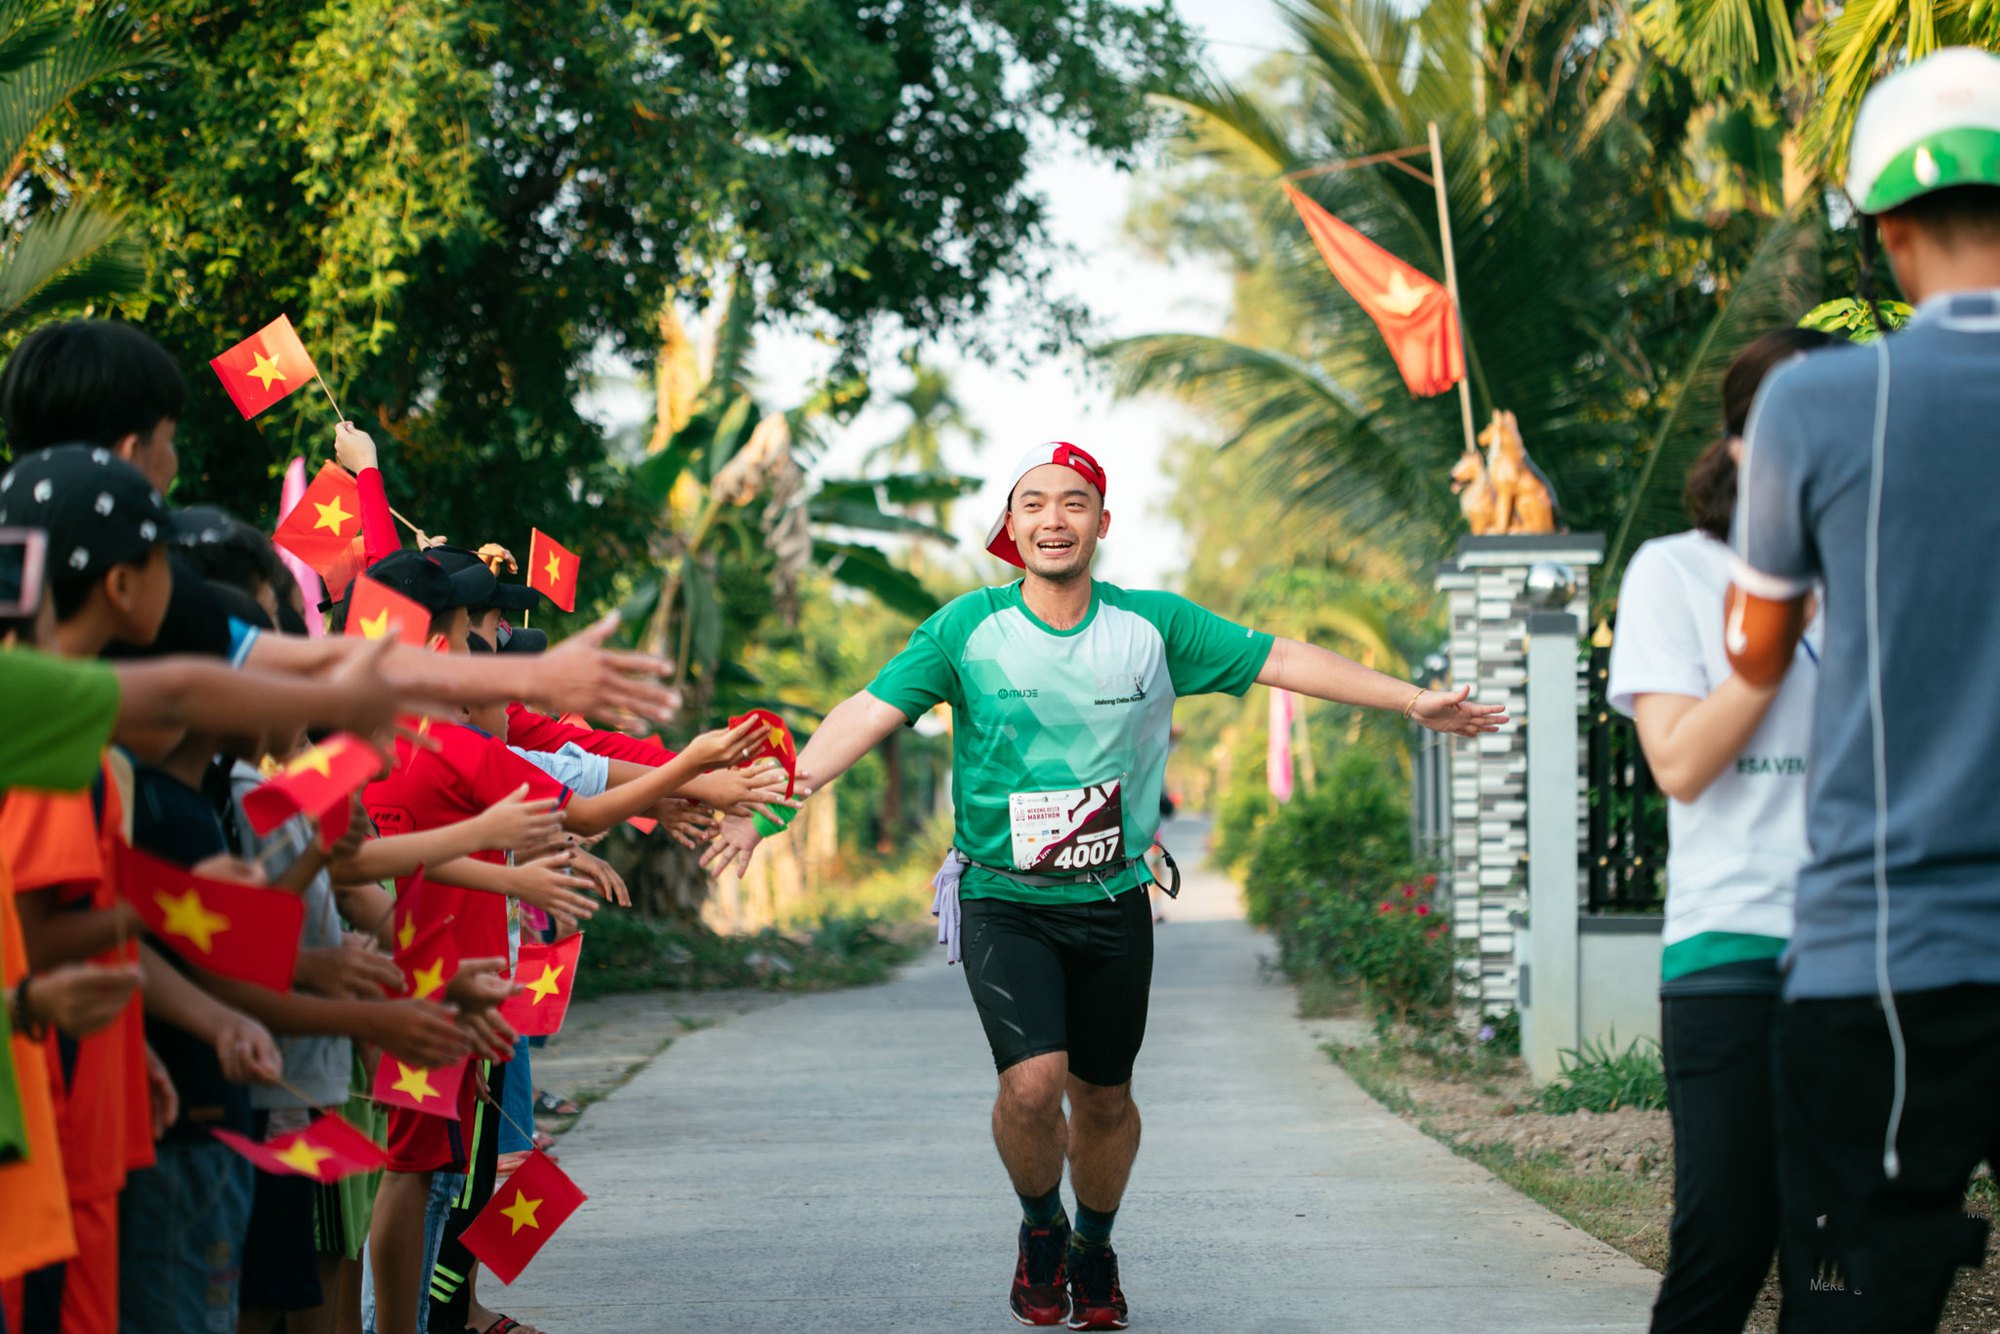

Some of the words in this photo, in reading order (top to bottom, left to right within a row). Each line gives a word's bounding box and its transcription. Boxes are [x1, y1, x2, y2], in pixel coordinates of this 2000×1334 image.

[1009, 689, 1039, 698] MUDE
[374, 812, 401, 822] FIFA
[1027, 812, 1061, 820] MARATHON
[1039, 849, 1052, 860] km
[1054, 836, 1119, 870] 4007
